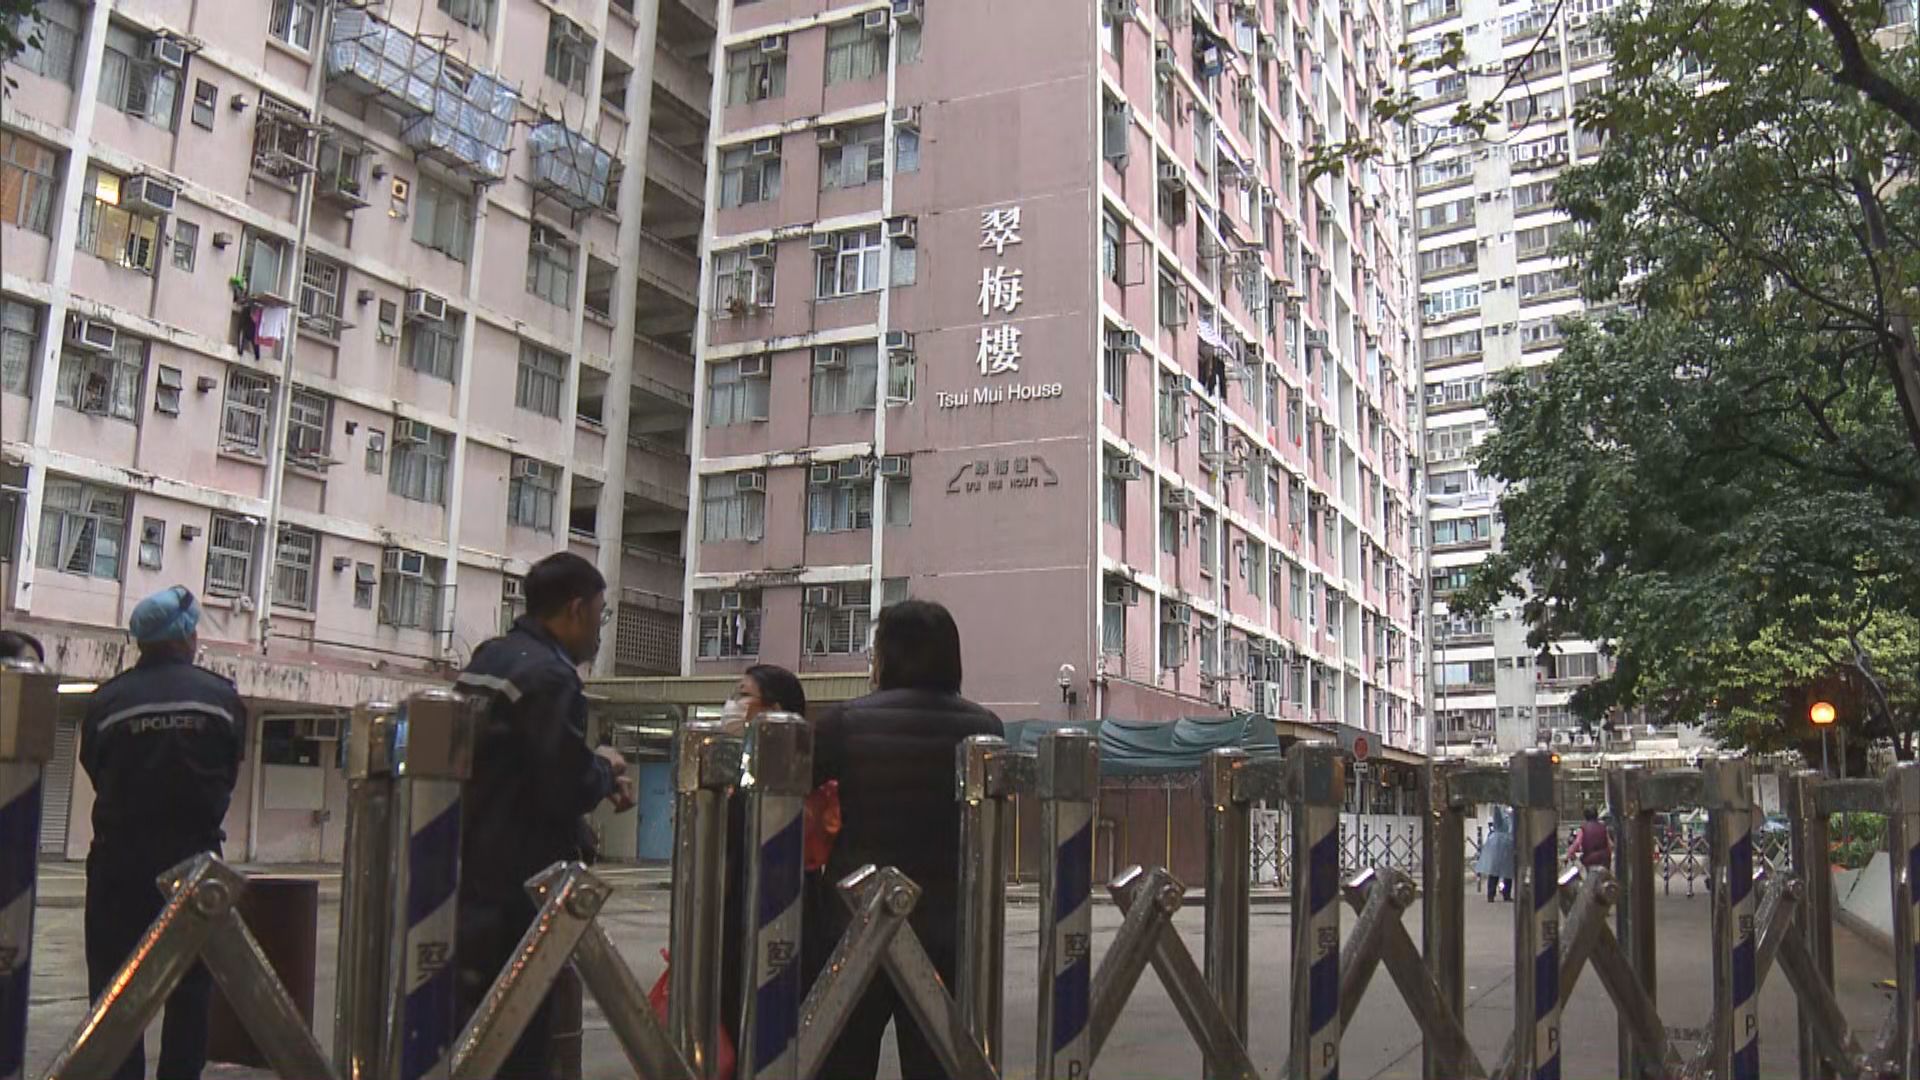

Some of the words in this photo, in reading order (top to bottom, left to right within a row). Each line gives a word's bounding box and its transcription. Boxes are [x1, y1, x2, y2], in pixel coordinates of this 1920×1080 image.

[976, 206, 1023, 376] 翠梅樓
[936, 388, 968, 408] Tsui
[973, 386, 1003, 405] Mui
[1008, 382, 1062, 401] House
[141, 716, 193, 732] POLICE
